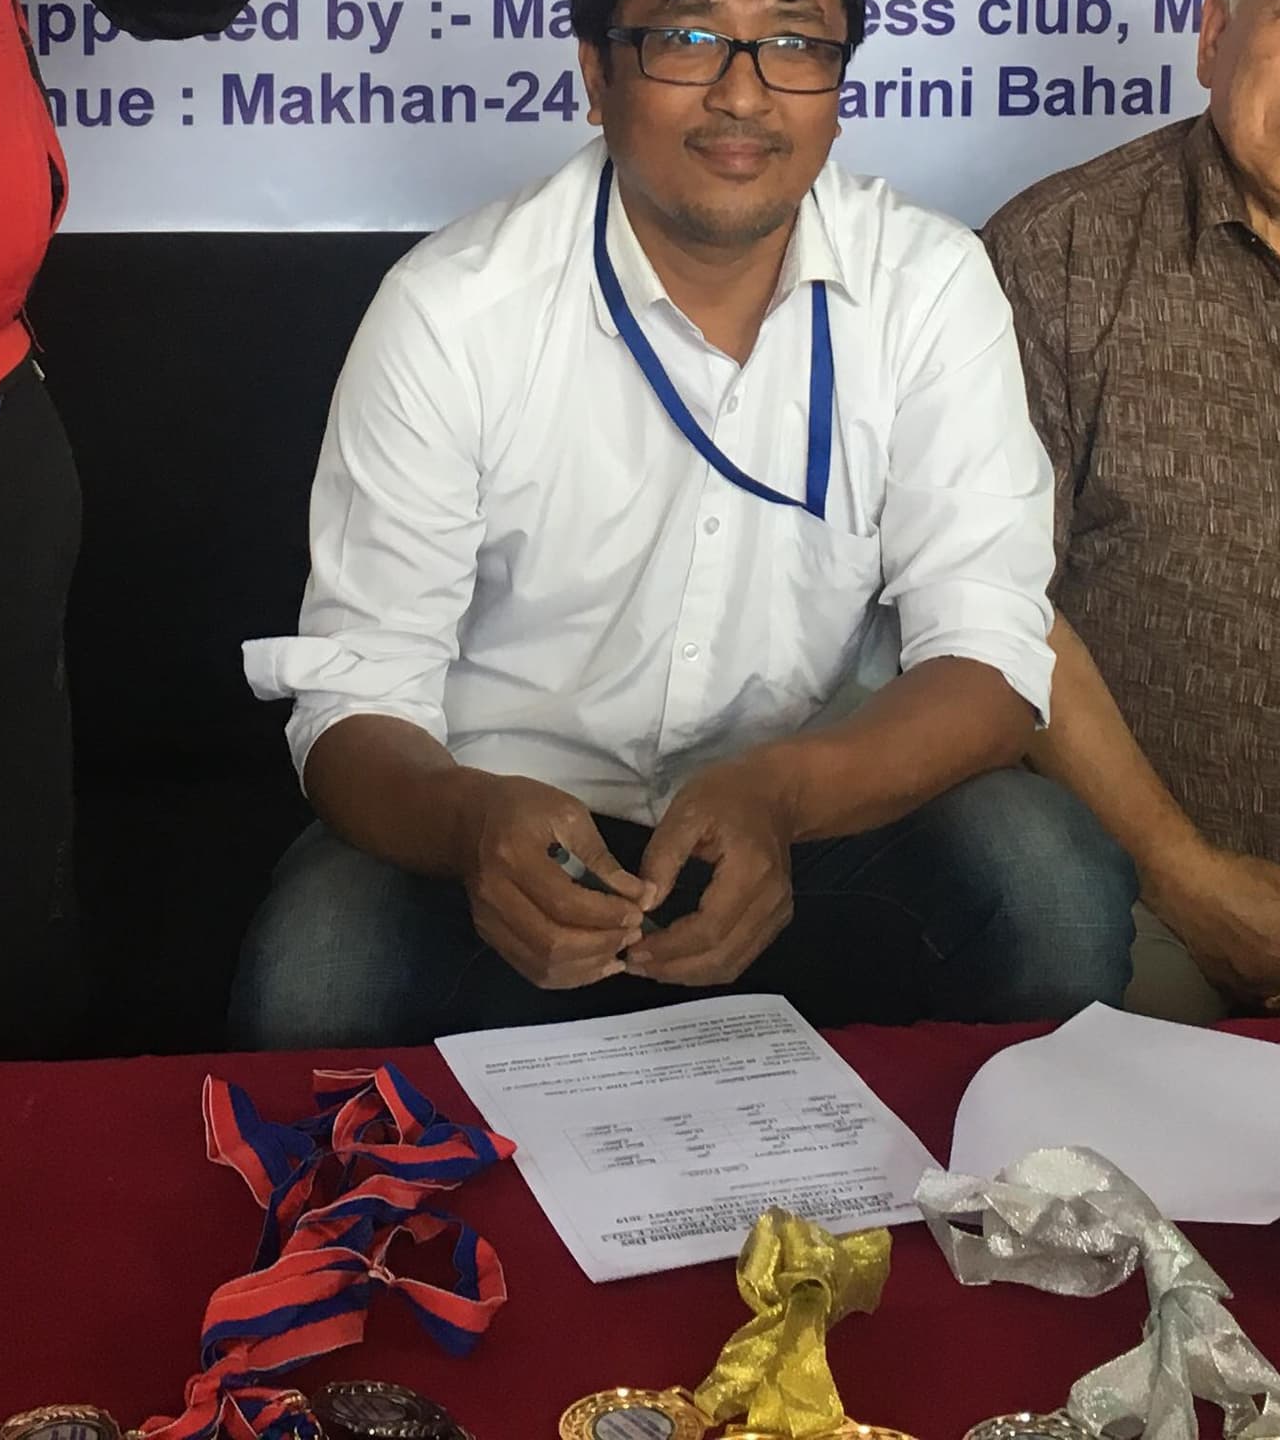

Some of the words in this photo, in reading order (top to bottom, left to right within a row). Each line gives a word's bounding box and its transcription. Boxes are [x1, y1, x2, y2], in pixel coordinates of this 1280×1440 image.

[45, 87, 155, 127] nue
[222, 70, 580, 126] Makhan-24
[838, 66, 974, 118] arini
[998, 65, 1173, 118] Bahal
